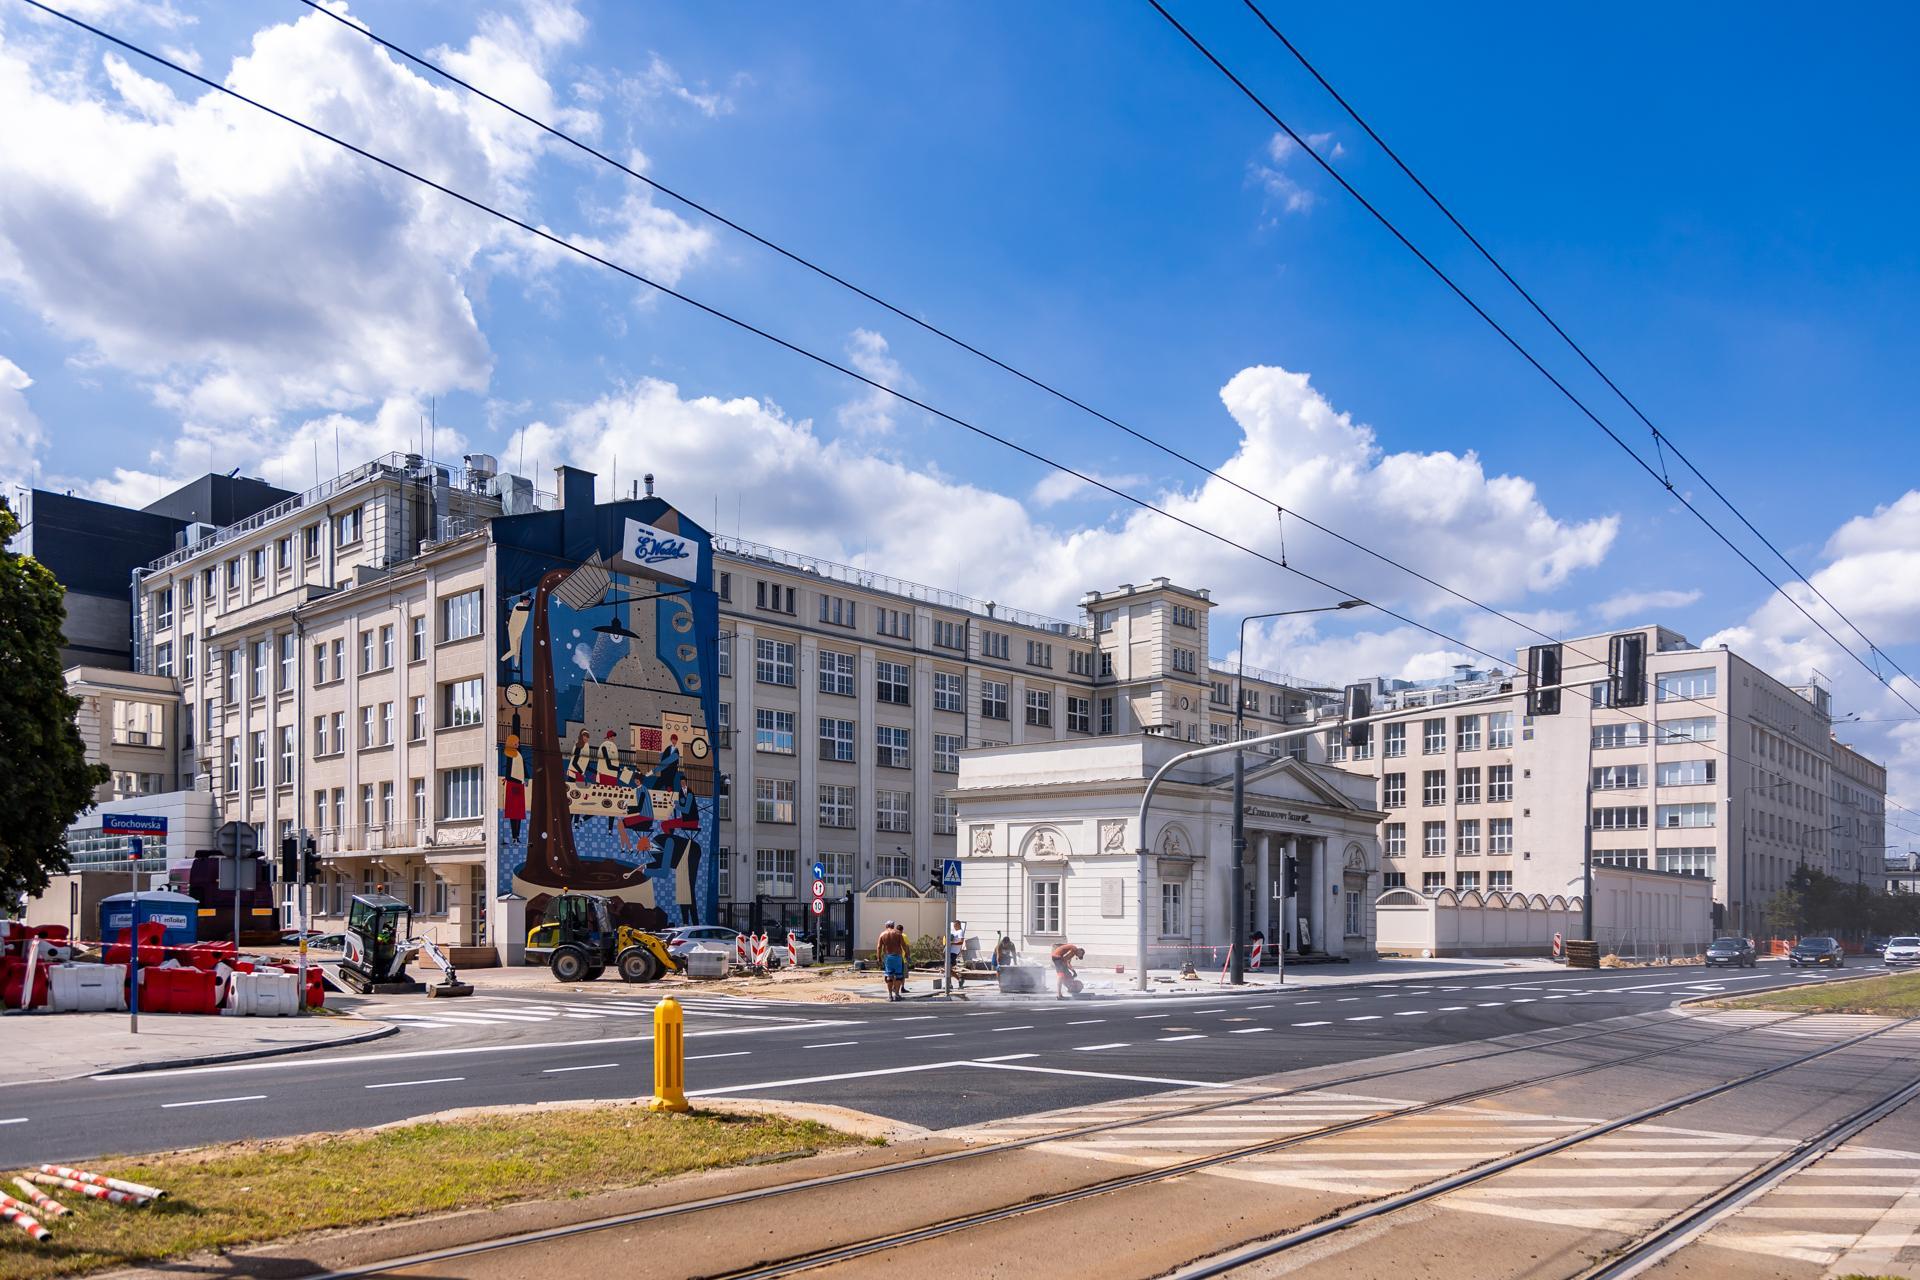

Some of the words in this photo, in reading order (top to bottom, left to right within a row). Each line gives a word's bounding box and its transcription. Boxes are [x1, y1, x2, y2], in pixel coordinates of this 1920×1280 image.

[110, 818, 161, 830] Grochowska
[814, 901, 822, 911] 10
[164, 916, 186, 924] mToilet
